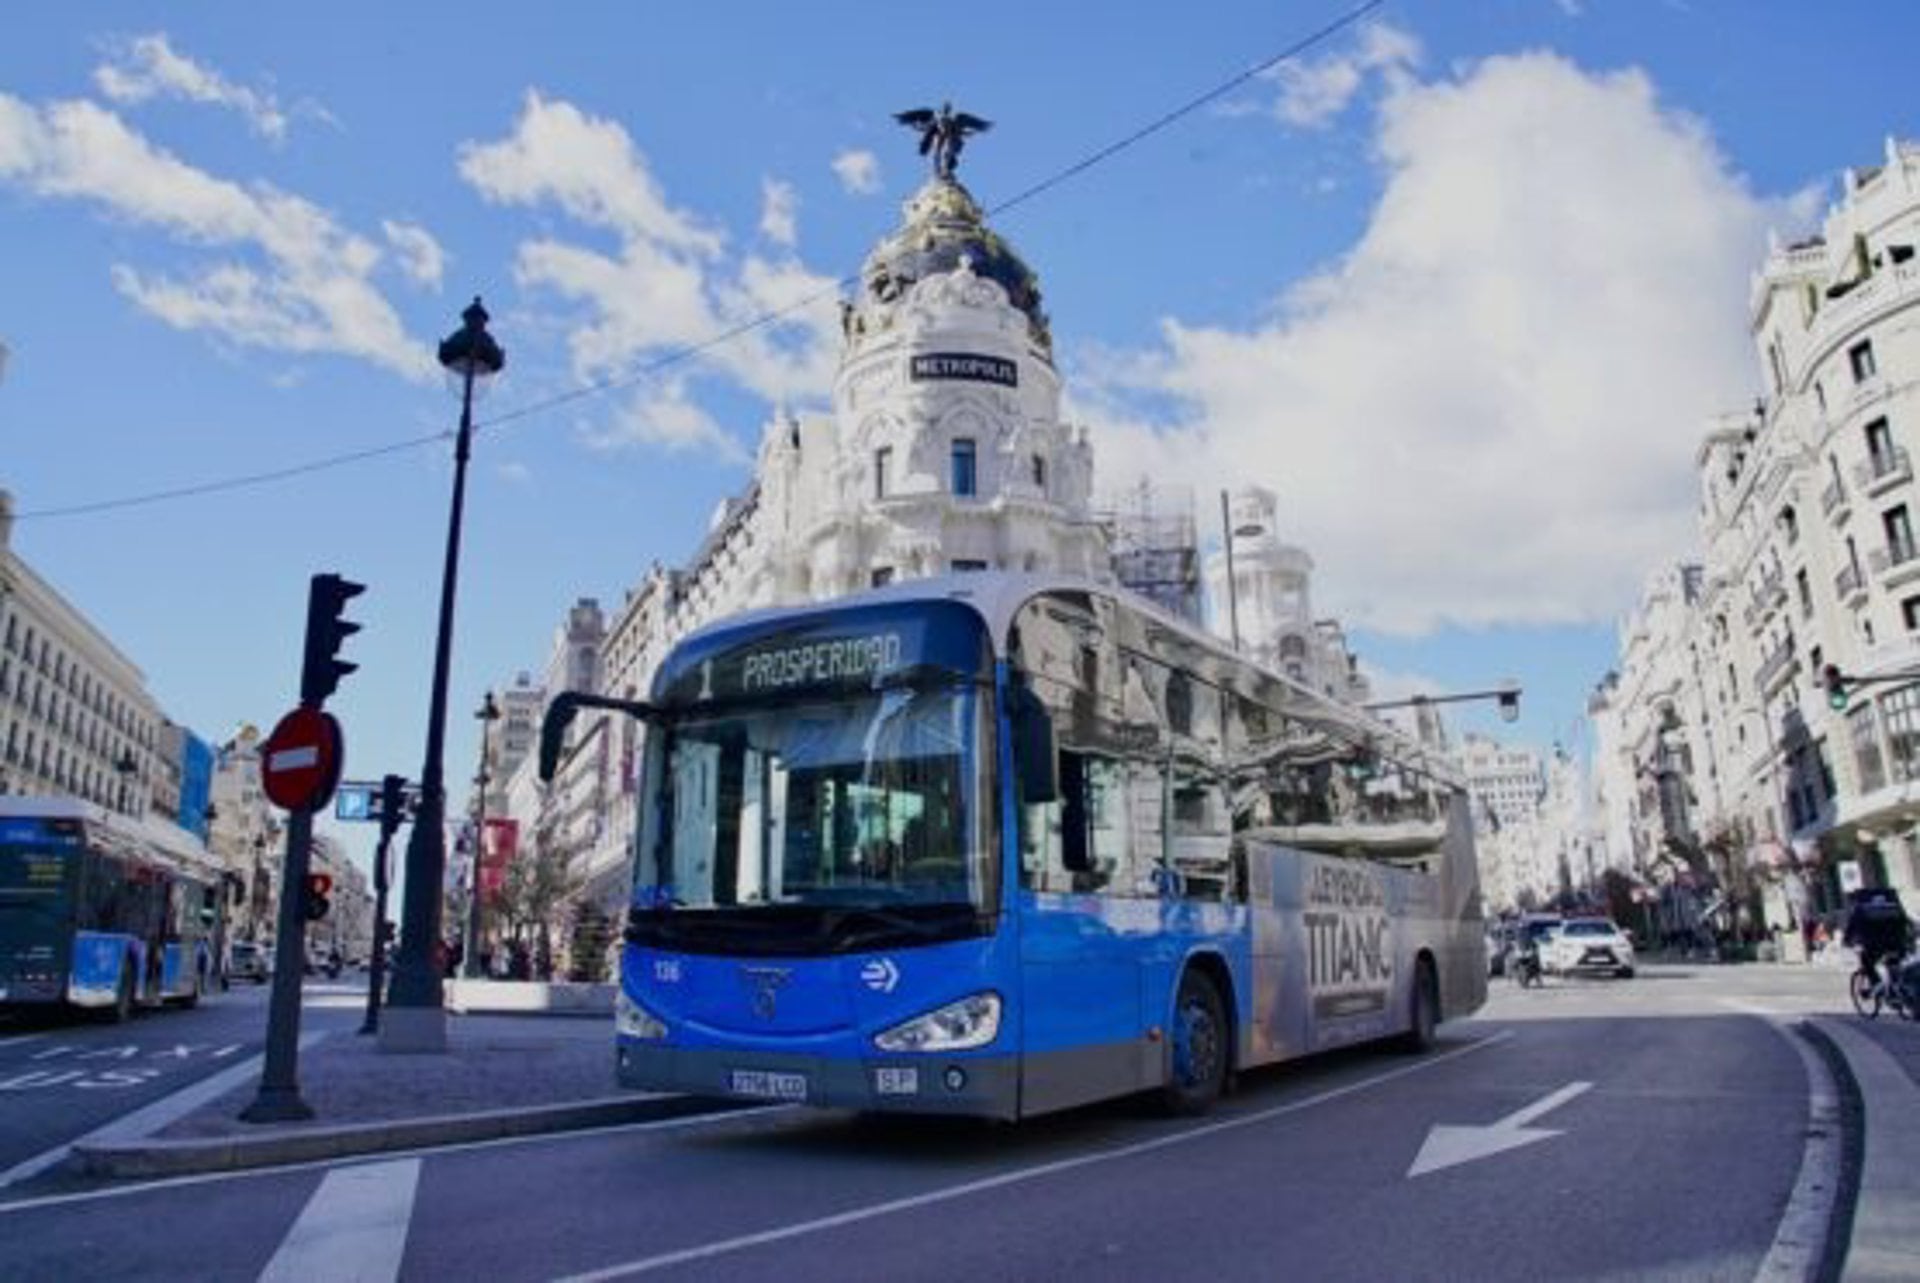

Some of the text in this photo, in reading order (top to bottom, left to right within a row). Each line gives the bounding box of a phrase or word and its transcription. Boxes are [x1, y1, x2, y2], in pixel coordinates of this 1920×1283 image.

[915, 357, 1015, 382] METROPOLIS
[698, 632, 901, 700] 1 PROSPERIDAD
[0, 1069, 161, 1090] US
